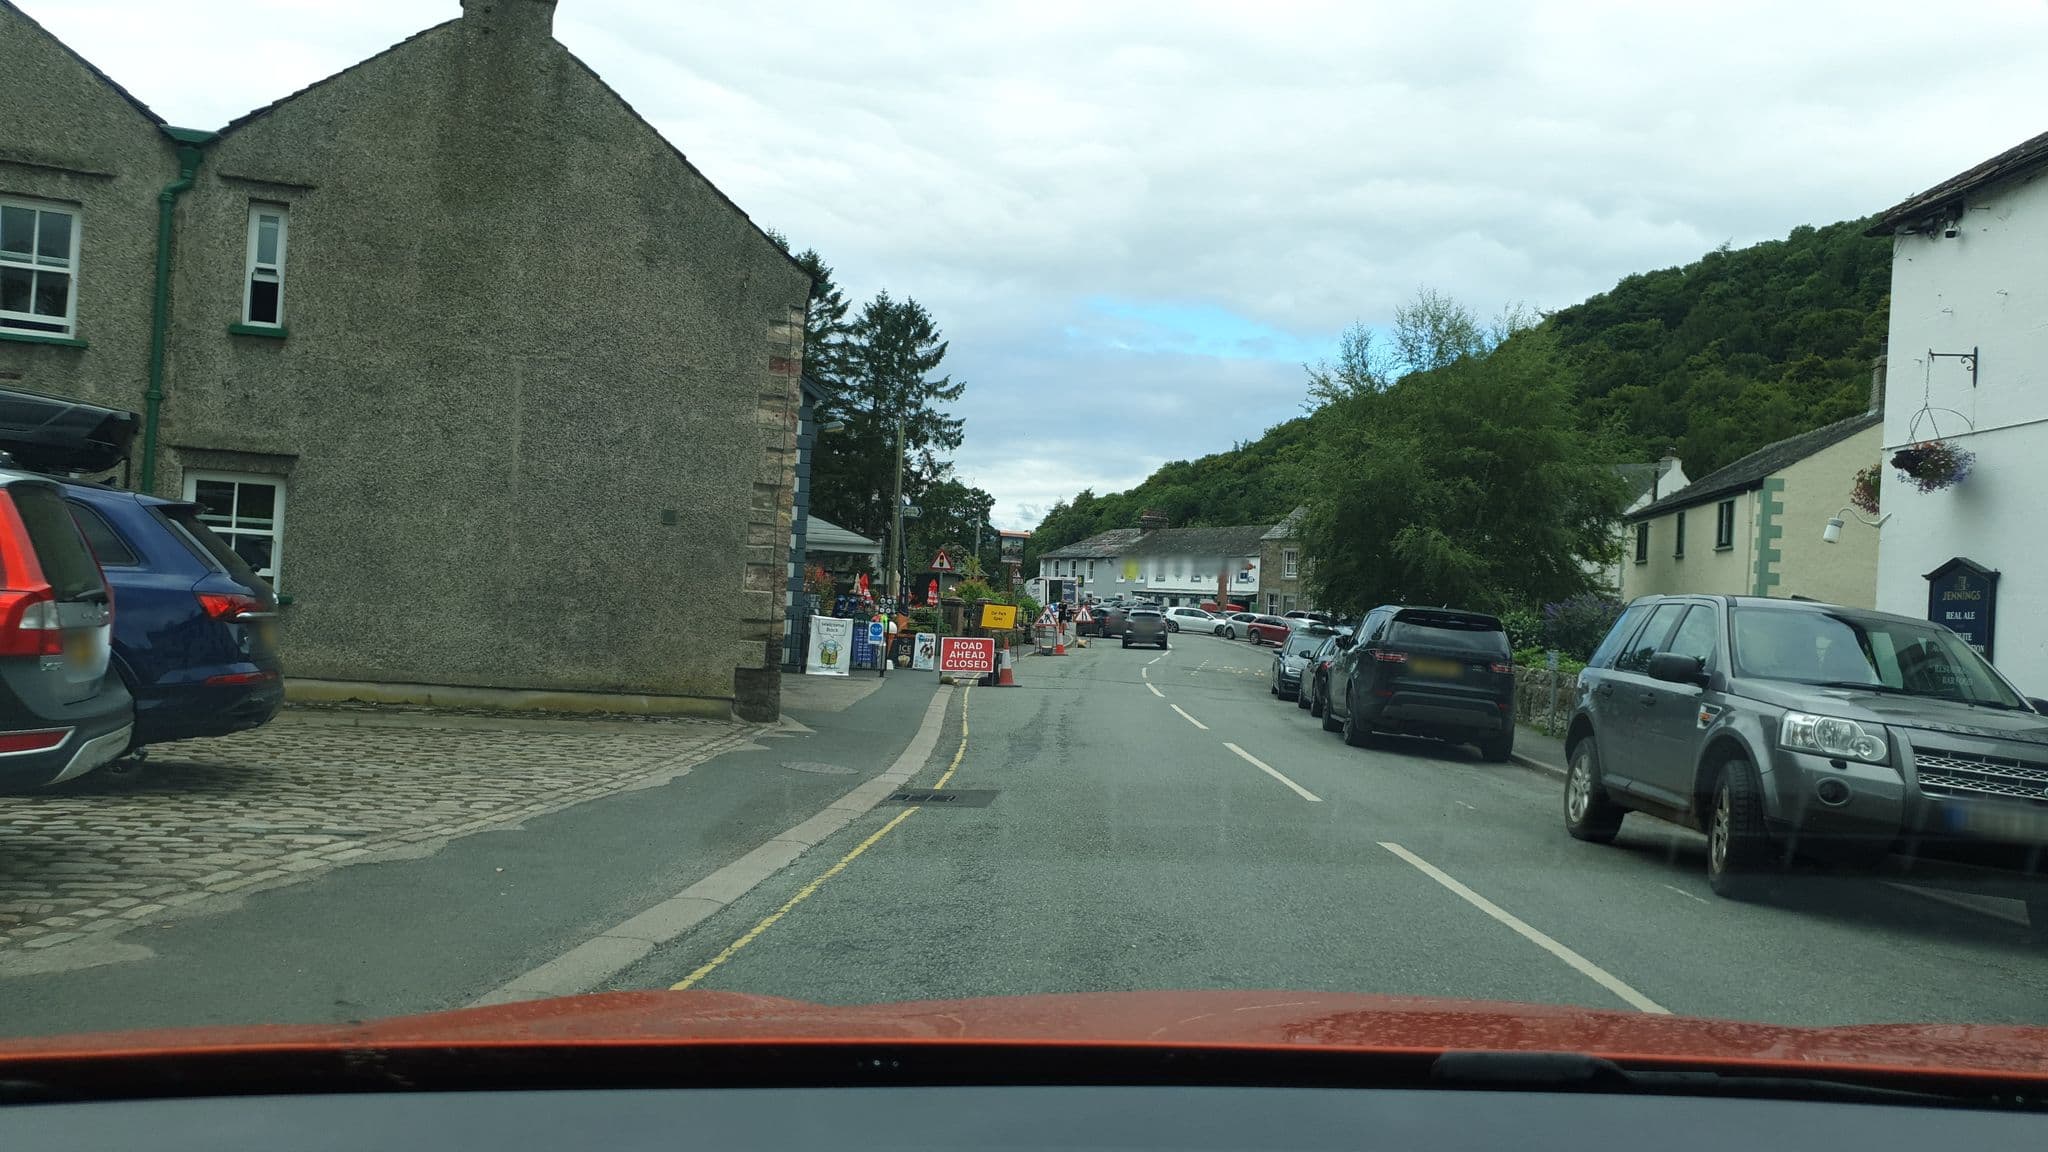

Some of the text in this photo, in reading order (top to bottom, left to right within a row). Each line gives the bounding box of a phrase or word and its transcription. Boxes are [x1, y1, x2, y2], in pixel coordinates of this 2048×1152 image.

[1942, 590, 1981, 601] JENNINGS
[1945, 611, 1976, 620] REAL ALE
[898, 644, 912, 652] ICE
[953, 641, 983, 650] ROAD
[949, 650, 986, 659] AHEAD
[946, 659, 988, 669] CLOSED
